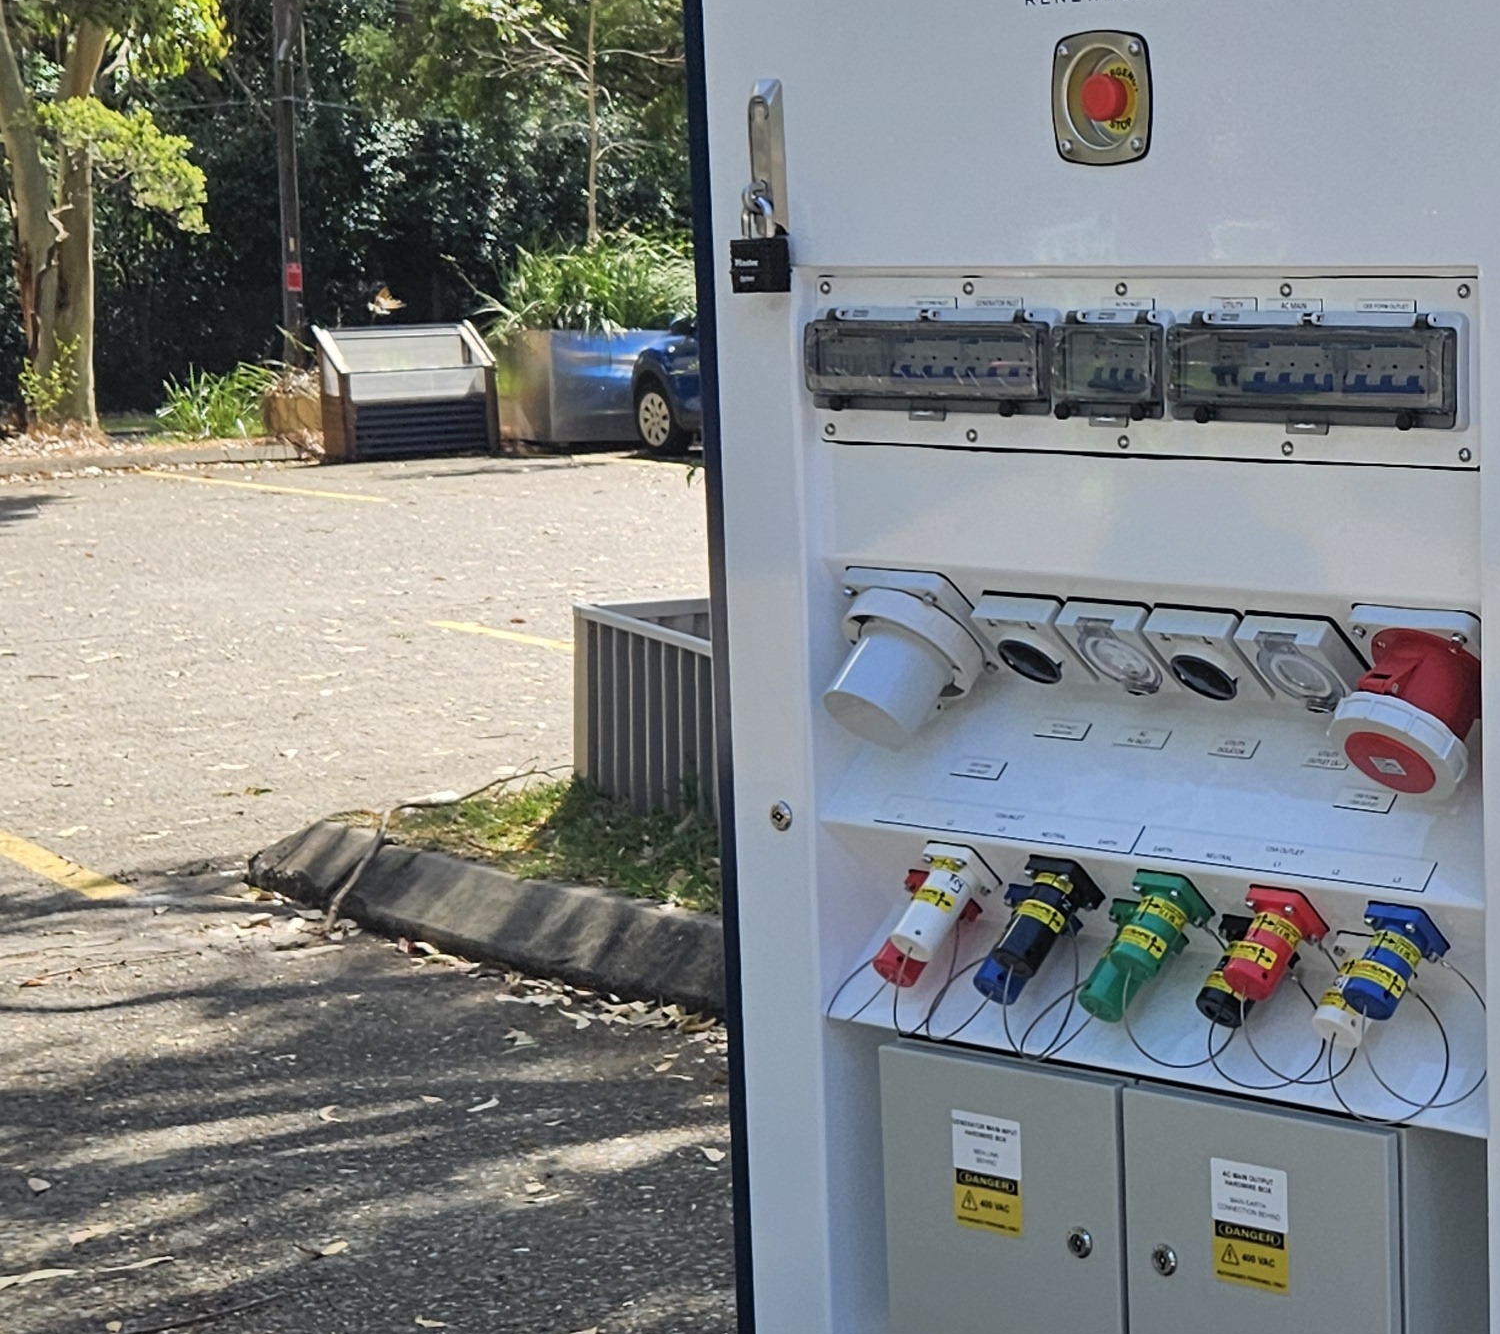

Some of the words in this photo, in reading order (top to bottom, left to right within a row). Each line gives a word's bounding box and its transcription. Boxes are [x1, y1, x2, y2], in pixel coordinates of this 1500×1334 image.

[1109, 117, 1132, 131] STOP
[1152, 845, 1173, 854] EARTH
[1279, 847, 1304, 857] OUTLET
[1206, 852, 1232, 862] NEUTRAL
[964, 1129, 994, 1141] HARDWIRE
[995, 1135, 1007, 1143] BOX
[986, 1124, 1001, 1133] MAIN
[1002, 1128, 1018, 1136] INPUT
[964, 1173, 1010, 1190] DANGER
[1222, 1170, 1232, 1178] AC
[1233, 1172, 1248, 1181] MAIN
[1248, 1174, 1274, 1185] OUTPUT
[1224, 1179, 1257, 1192] HARDWIRE
[1258, 1185, 1272, 1195] BOX
[994, 1201, 1010, 1214] VAC
[1224, 1225, 1275, 1244] DANGER
[1258, 1254, 1276, 1268] VAC
